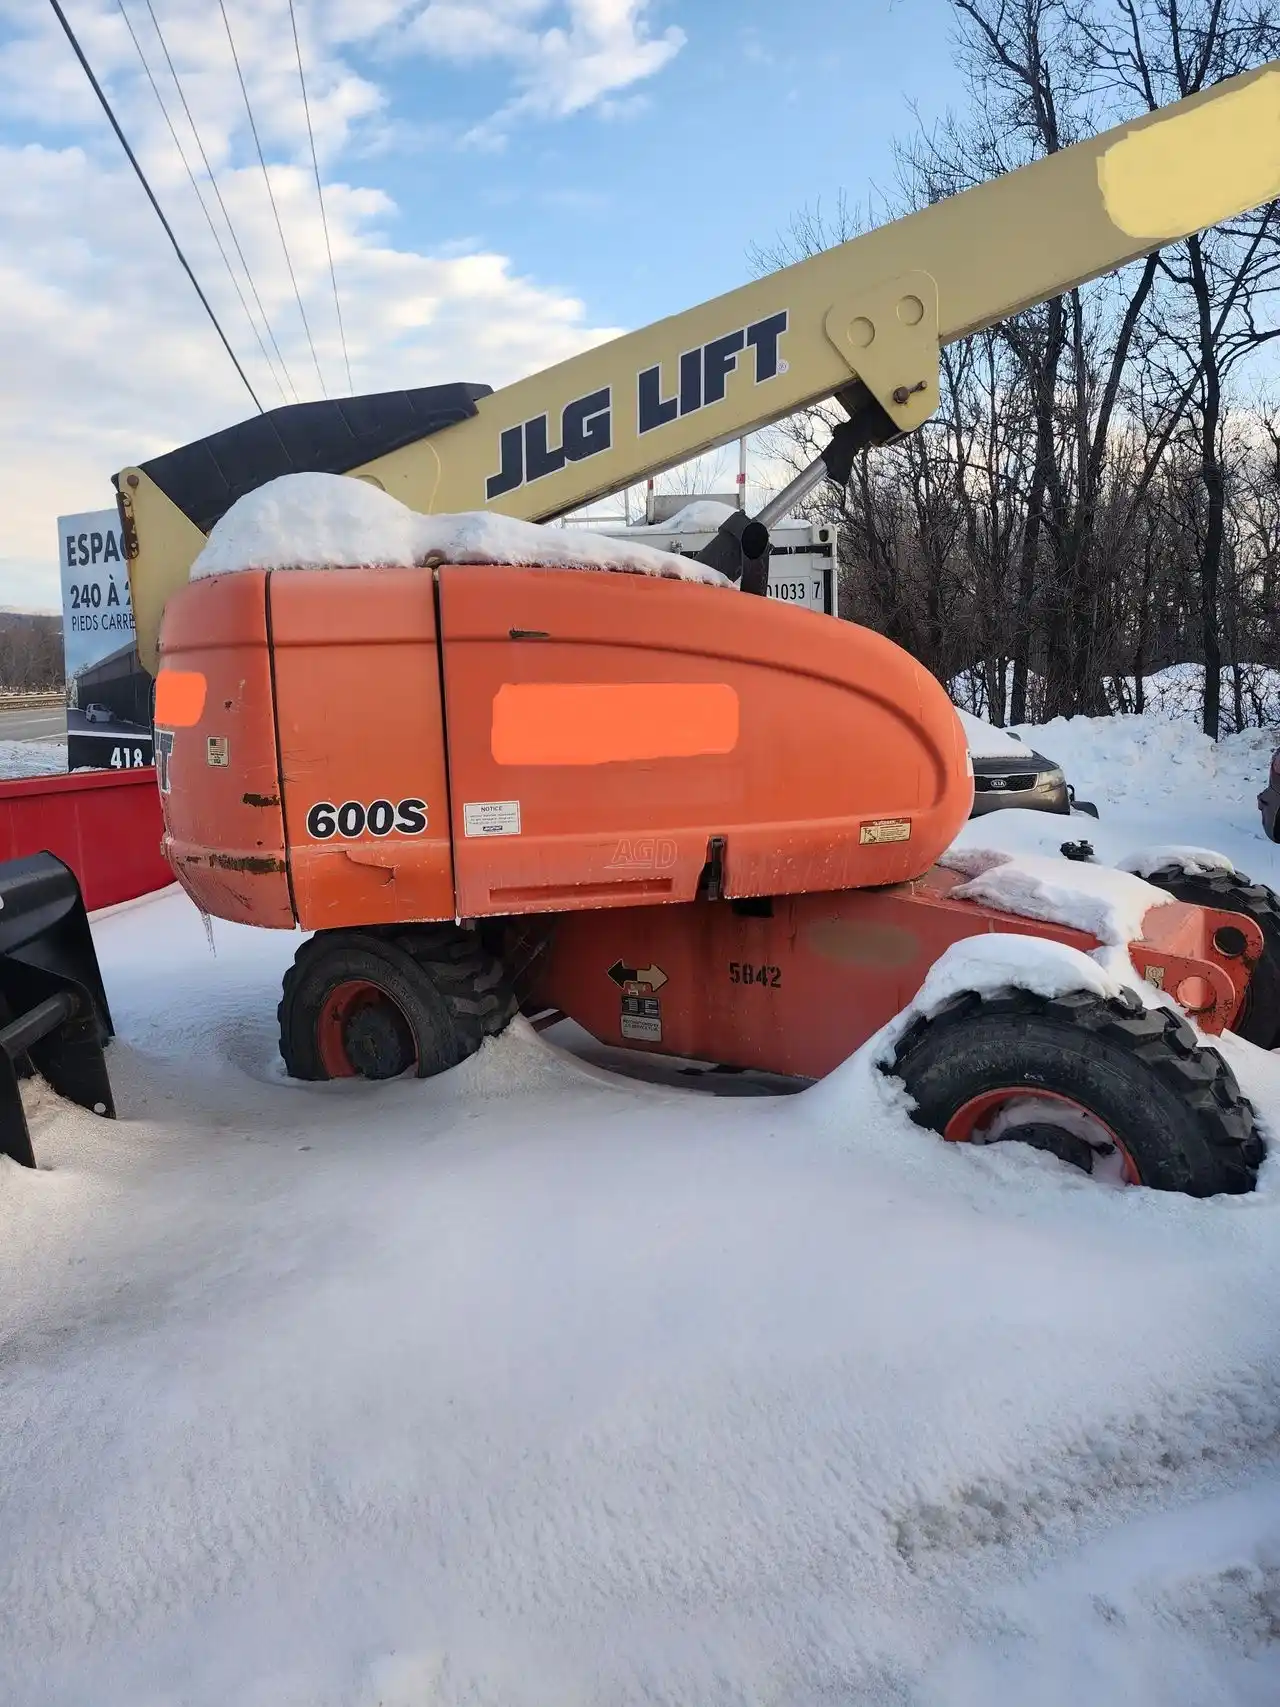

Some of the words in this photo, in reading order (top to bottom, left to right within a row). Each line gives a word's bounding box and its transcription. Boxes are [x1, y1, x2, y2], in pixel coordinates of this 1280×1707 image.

[485, 385, 612, 502] JLG
[637, 309, 788, 436] LIFT
[70, 583, 102, 609] 240
[107, 574, 120, 607] À
[72, 614, 99, 631] PIEDS
[110, 747, 144, 769] 418
[306, 798, 429, 840] 600S
[611, 839, 678, 869] AGD
[729, 962, 782, 989] 5842
